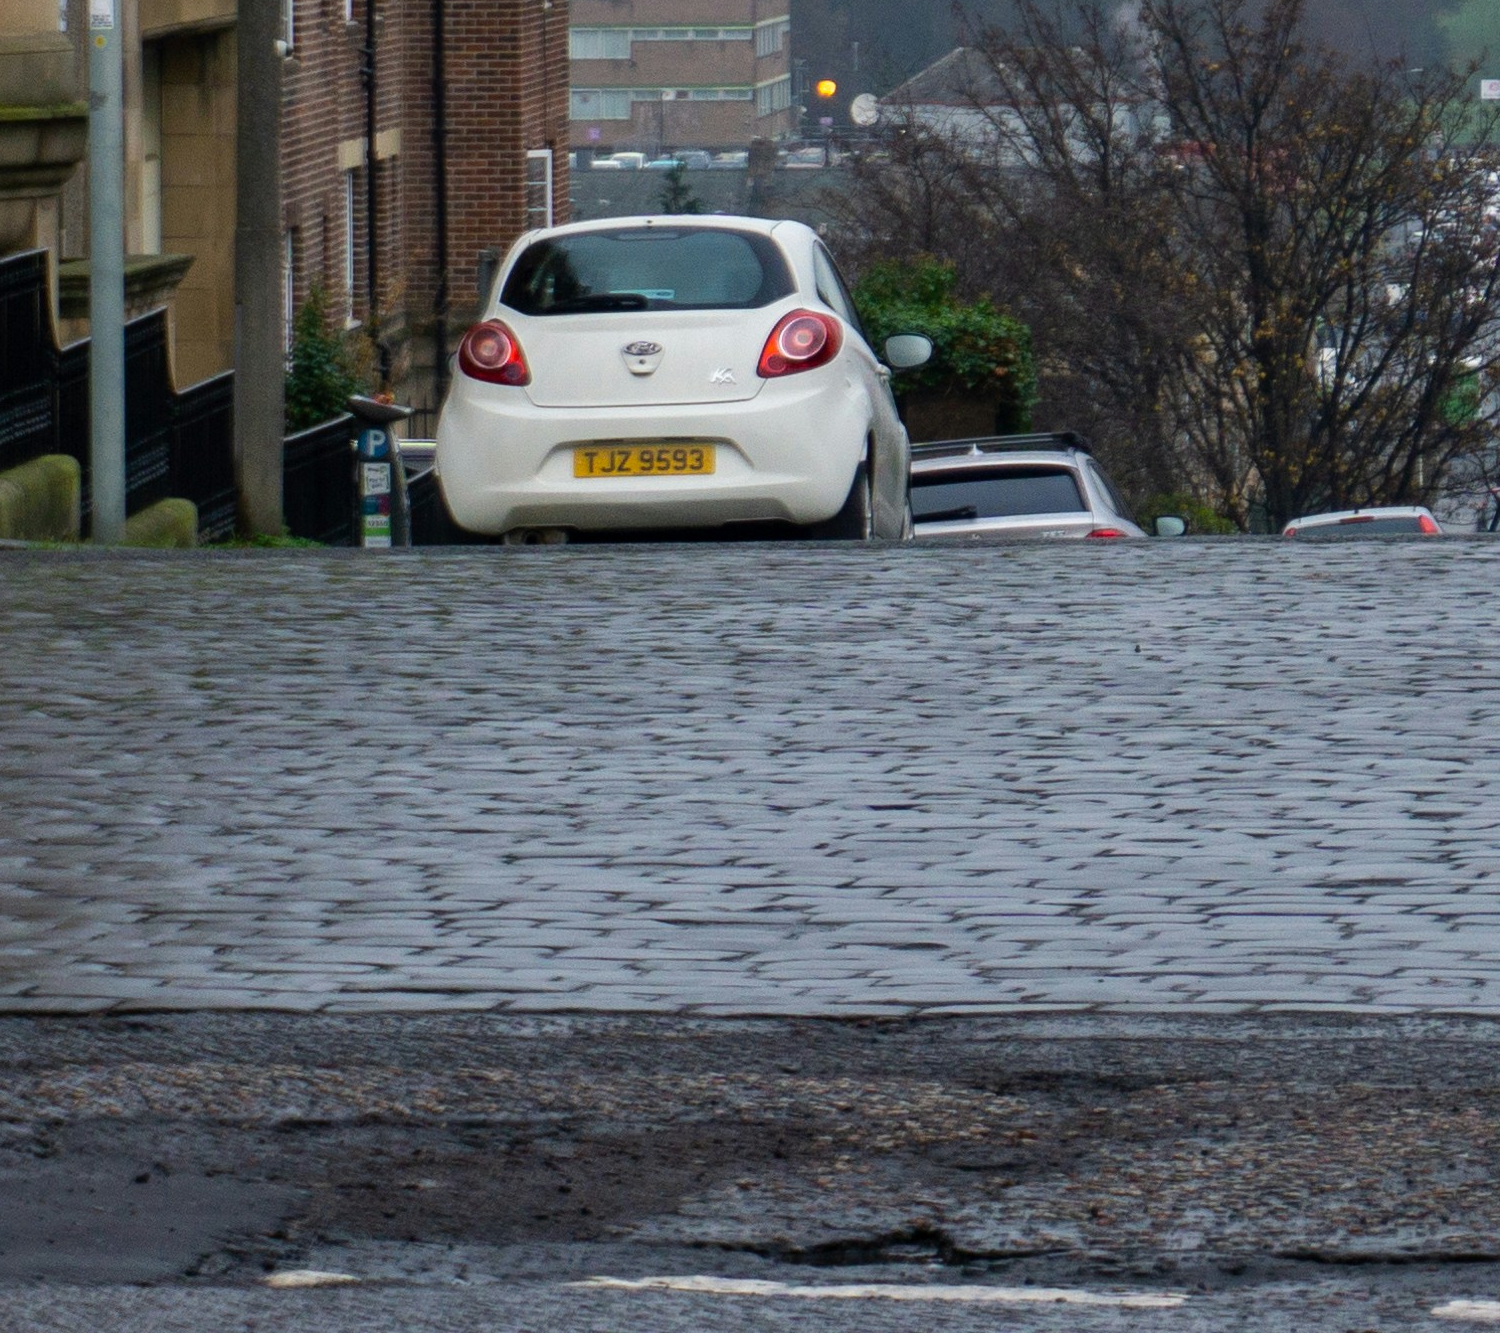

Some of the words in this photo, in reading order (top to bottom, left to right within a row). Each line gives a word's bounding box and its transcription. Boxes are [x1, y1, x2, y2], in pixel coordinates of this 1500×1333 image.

[367, 429, 386, 456] P
[584, 451, 632, 473] TJZ
[639, 448, 704, 472] 9593
